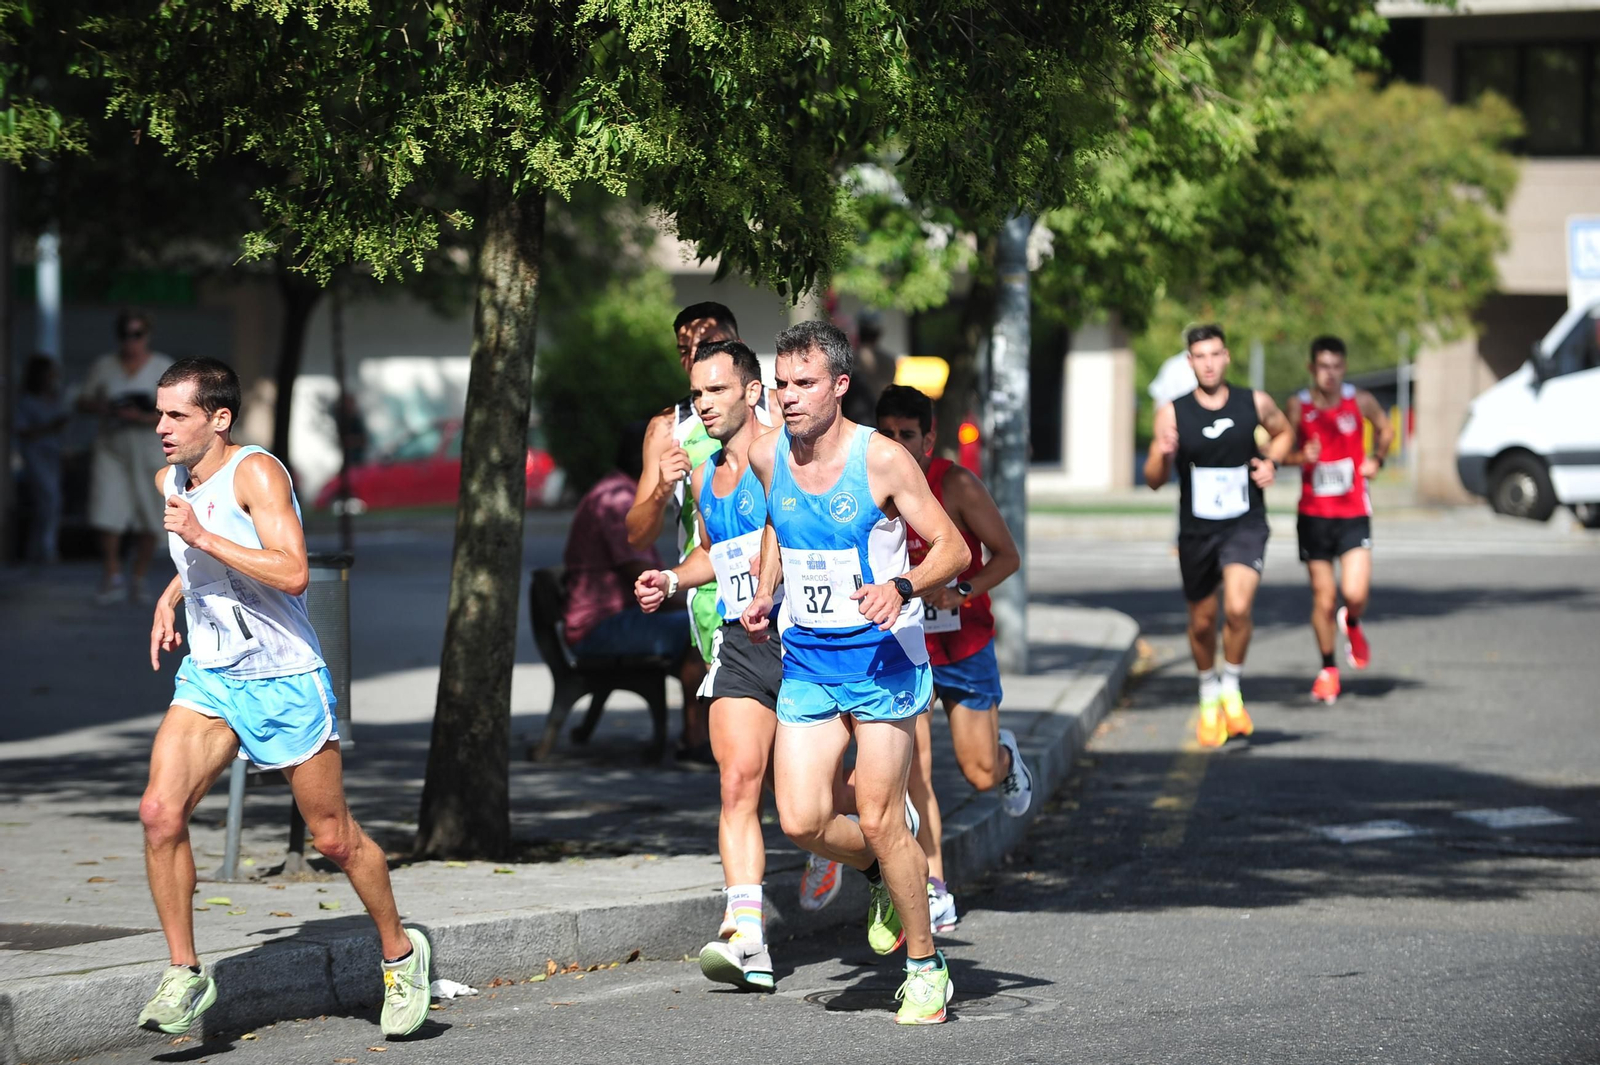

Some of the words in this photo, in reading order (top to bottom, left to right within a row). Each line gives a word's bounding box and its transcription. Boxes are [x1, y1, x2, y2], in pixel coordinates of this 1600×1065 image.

[730, 570, 755, 602] 27
[801, 574, 828, 582] MARCOS
[803, 585, 834, 614] 32
